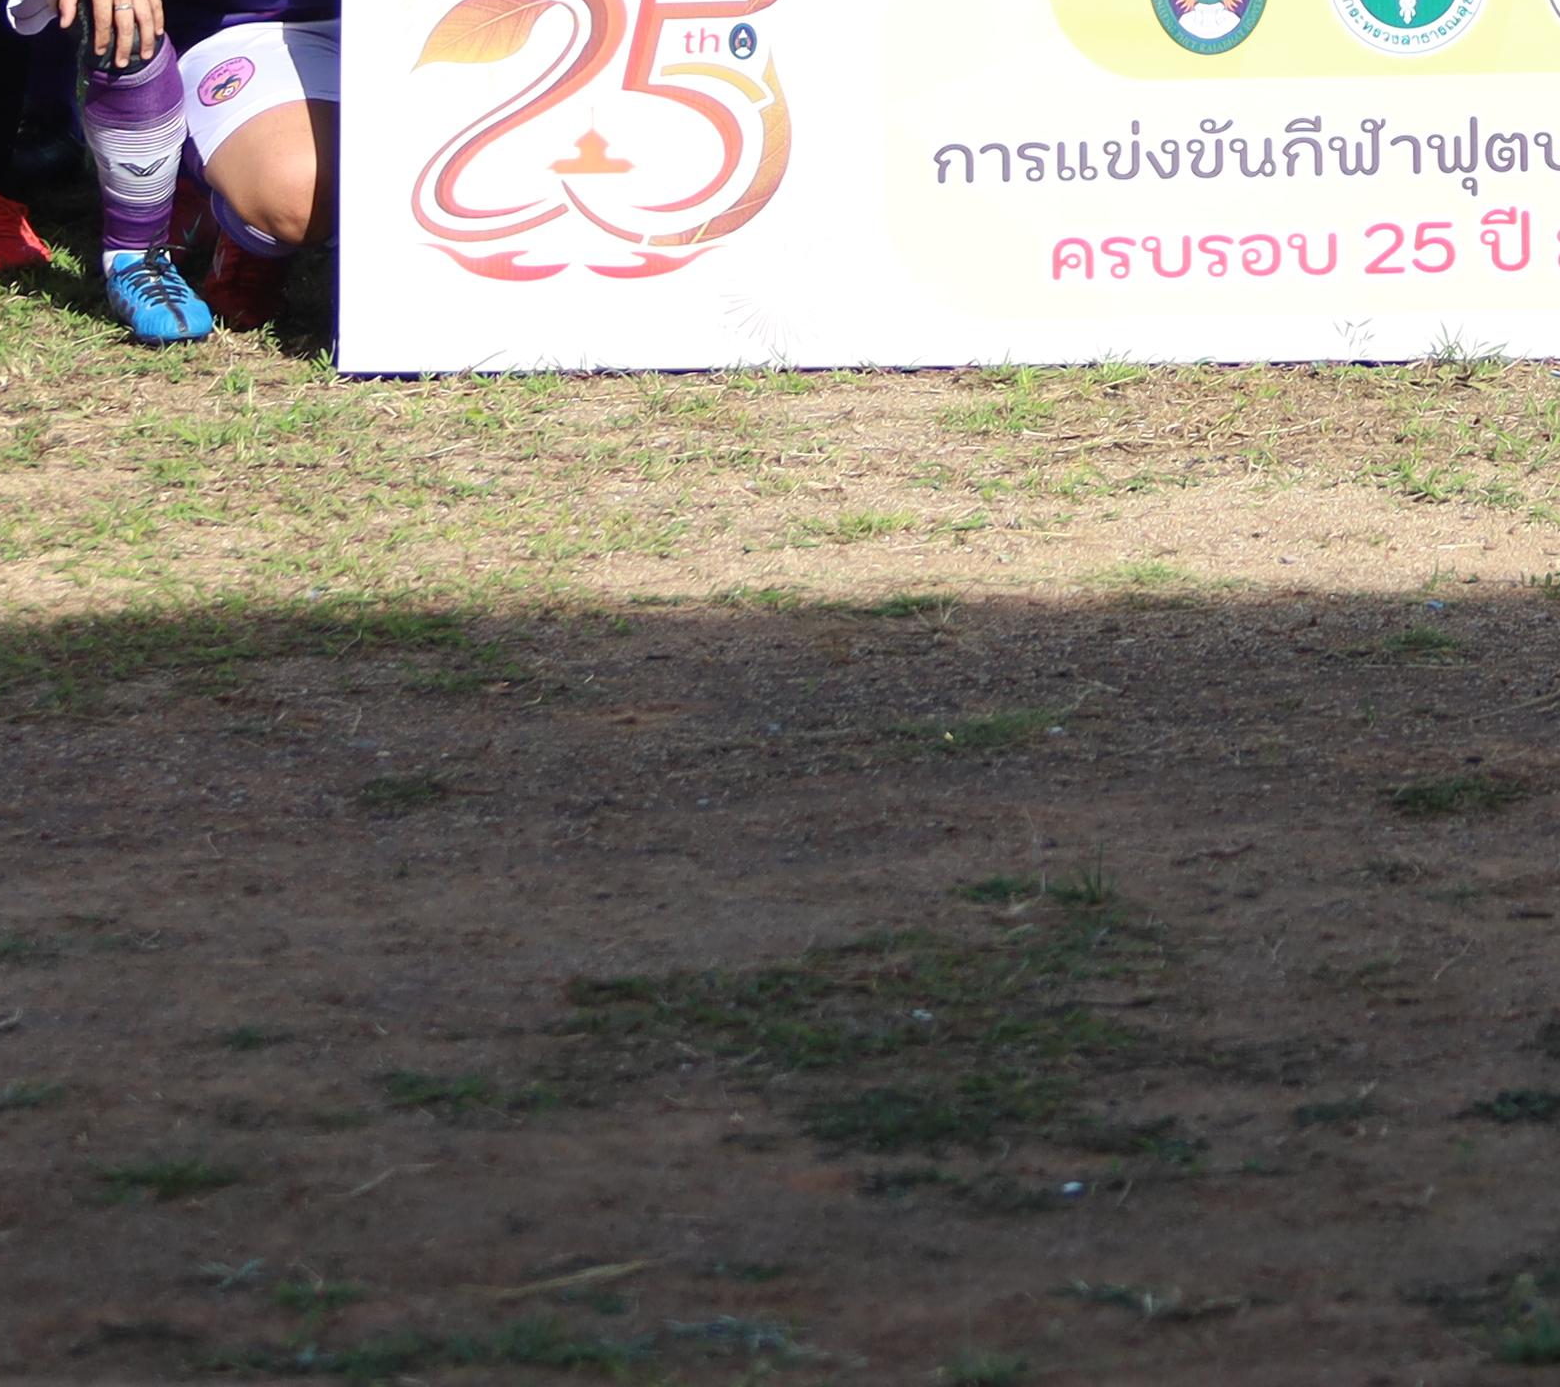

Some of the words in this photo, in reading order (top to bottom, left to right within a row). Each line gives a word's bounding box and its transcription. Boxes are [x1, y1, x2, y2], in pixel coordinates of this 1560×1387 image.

[682, 27, 720, 55] th
[1051, 232, 1338, 280] ครบรอบ
[1364, 222, 1456, 274] 25
[1479, 206, 1531, 271] ปี
